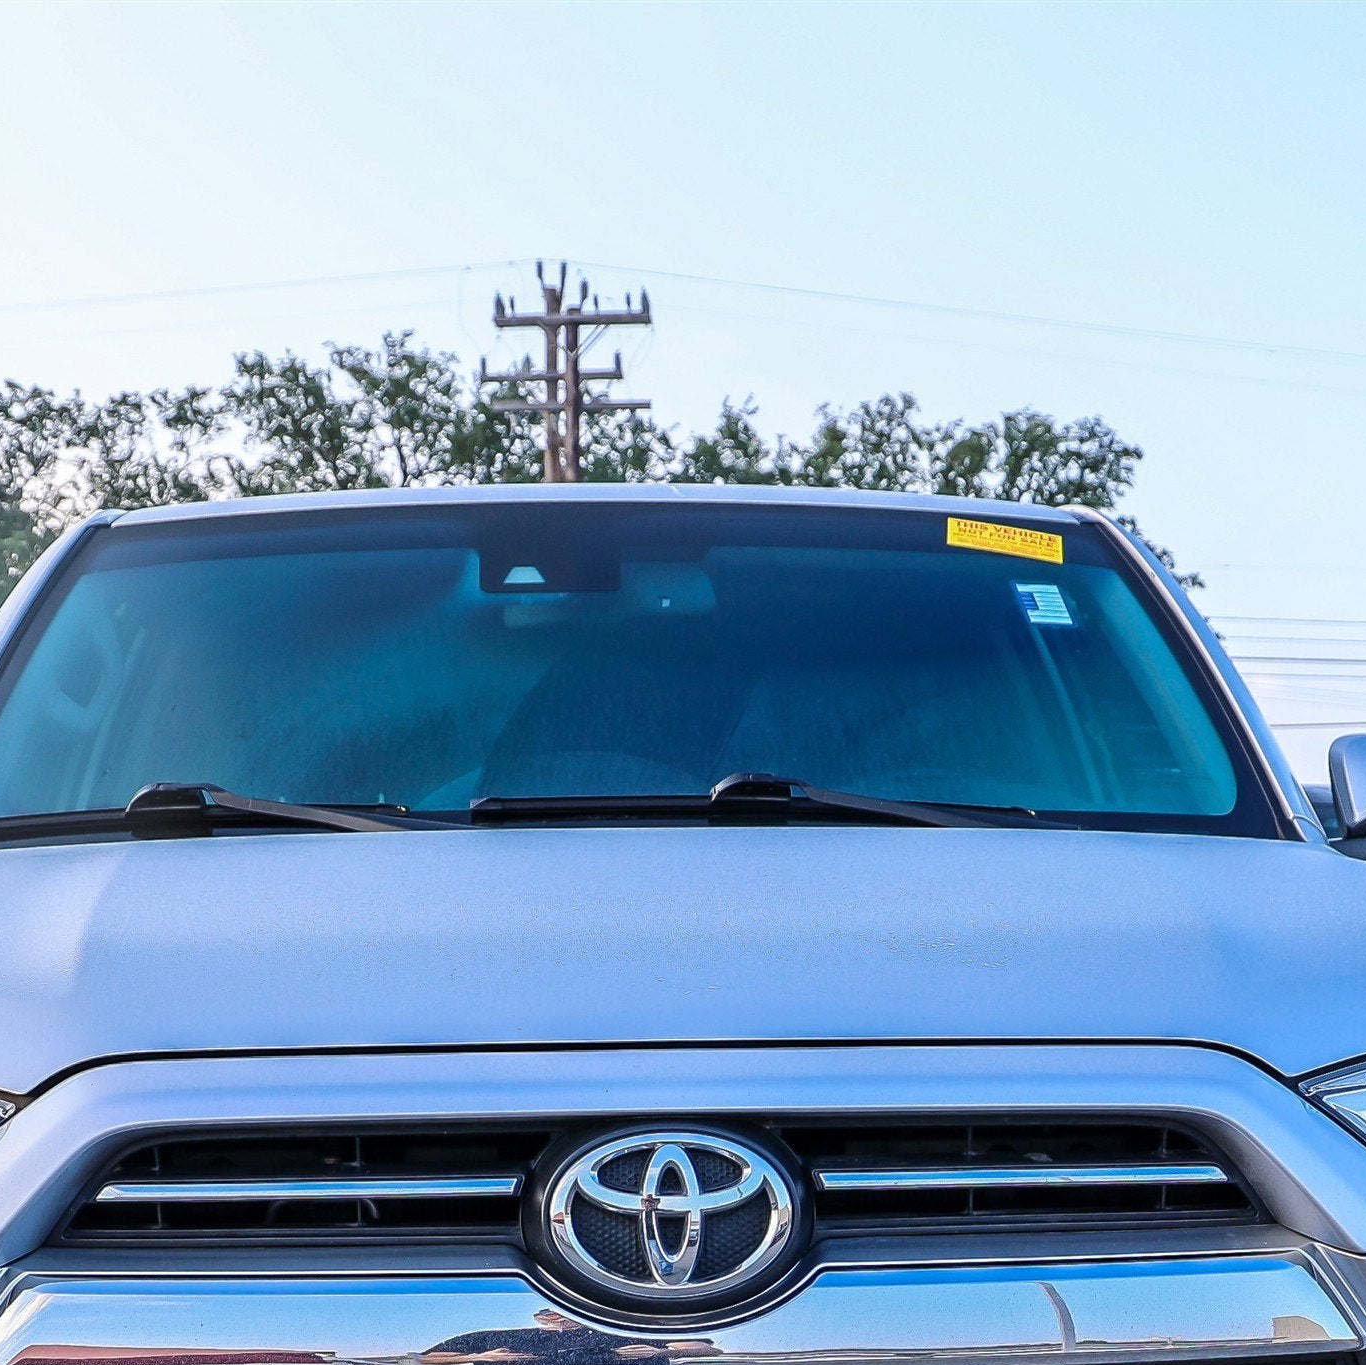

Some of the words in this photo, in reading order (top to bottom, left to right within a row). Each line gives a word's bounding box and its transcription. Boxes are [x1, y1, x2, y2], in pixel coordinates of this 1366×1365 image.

[956, 520, 988, 531] THIS
[994, 526, 1057, 543] VEHICLE
[958, 527, 986, 536] NOT
[989, 532, 1016, 541] FOR
[1020, 536, 1055, 548] SALE
